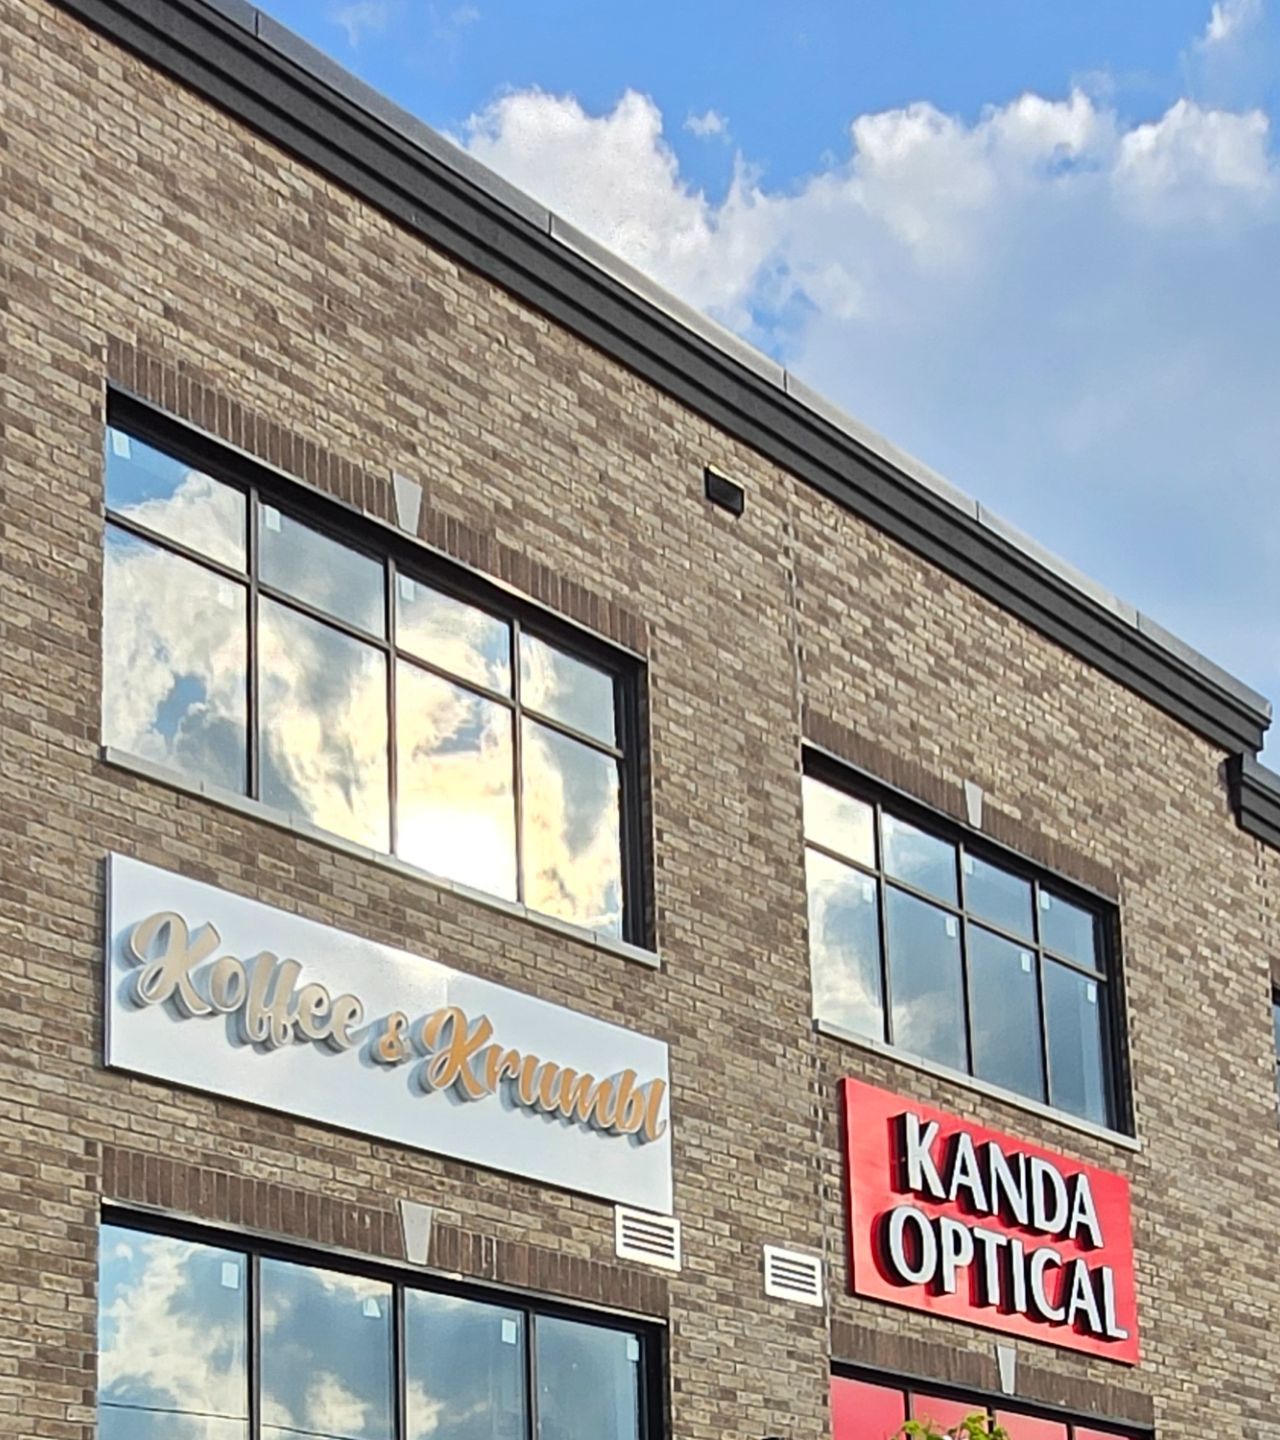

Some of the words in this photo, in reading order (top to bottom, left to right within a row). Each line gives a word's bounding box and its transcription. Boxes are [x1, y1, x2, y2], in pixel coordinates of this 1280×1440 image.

[125, 911, 365, 1054] Koffee
[375, 1011, 411, 1065] &
[419, 1006, 667, 1143] Krumbl
[899, 1111, 1104, 1249] KANDA
[884, 1204, 1129, 1341] OPTICAL
